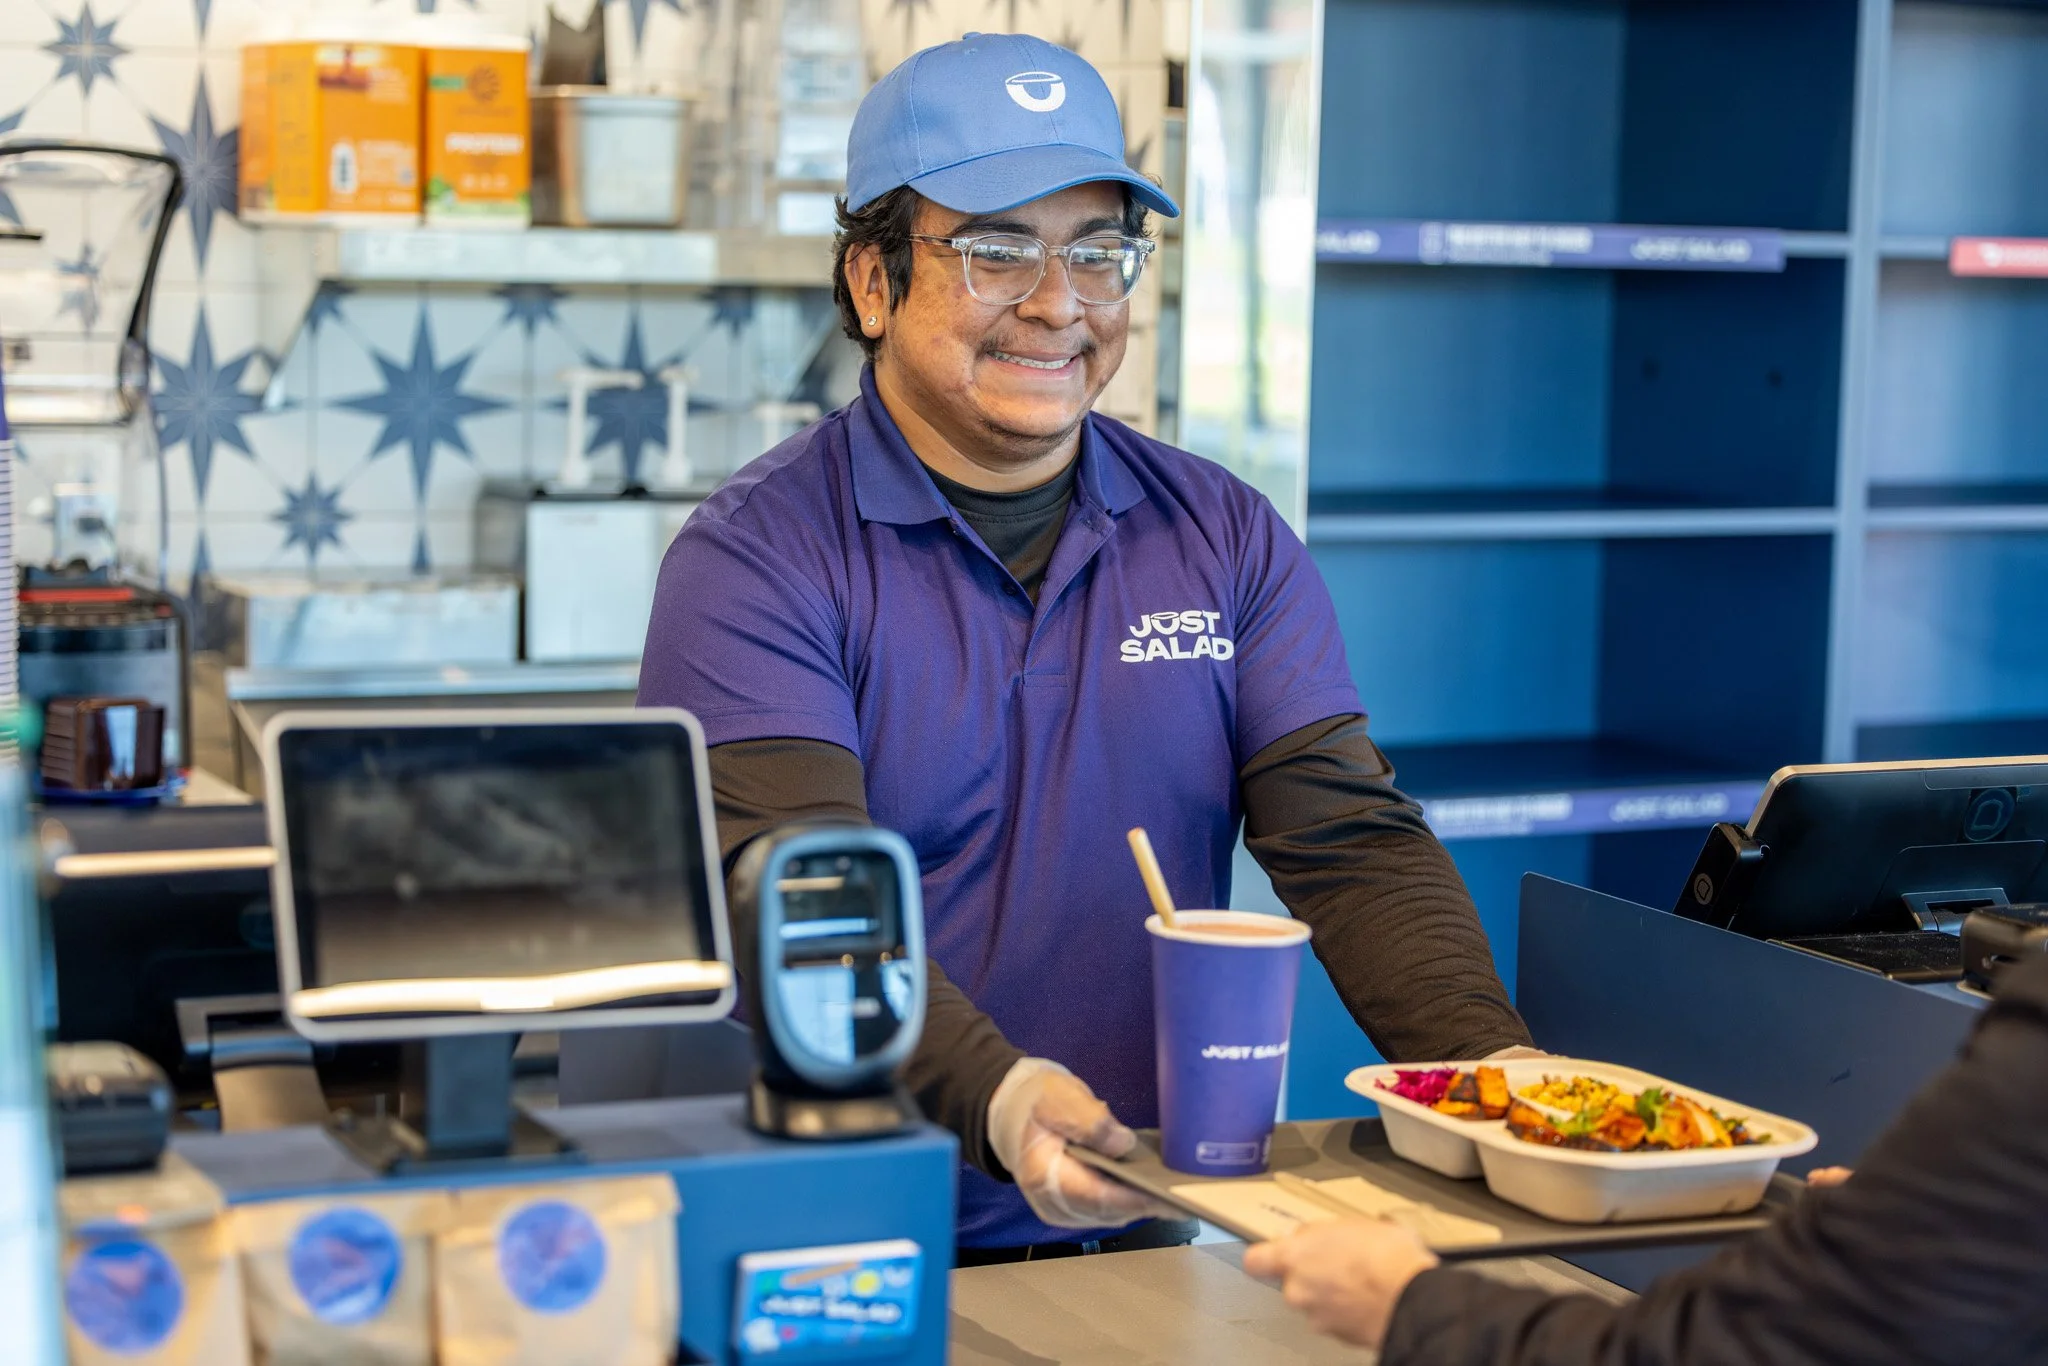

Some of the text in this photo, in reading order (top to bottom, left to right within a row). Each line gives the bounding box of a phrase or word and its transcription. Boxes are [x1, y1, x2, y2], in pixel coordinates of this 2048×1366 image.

[1129, 610, 1220, 638] JUST
[1120, 635, 1234, 663] SALAD
[1201, 1044, 1252, 1060] JUST
